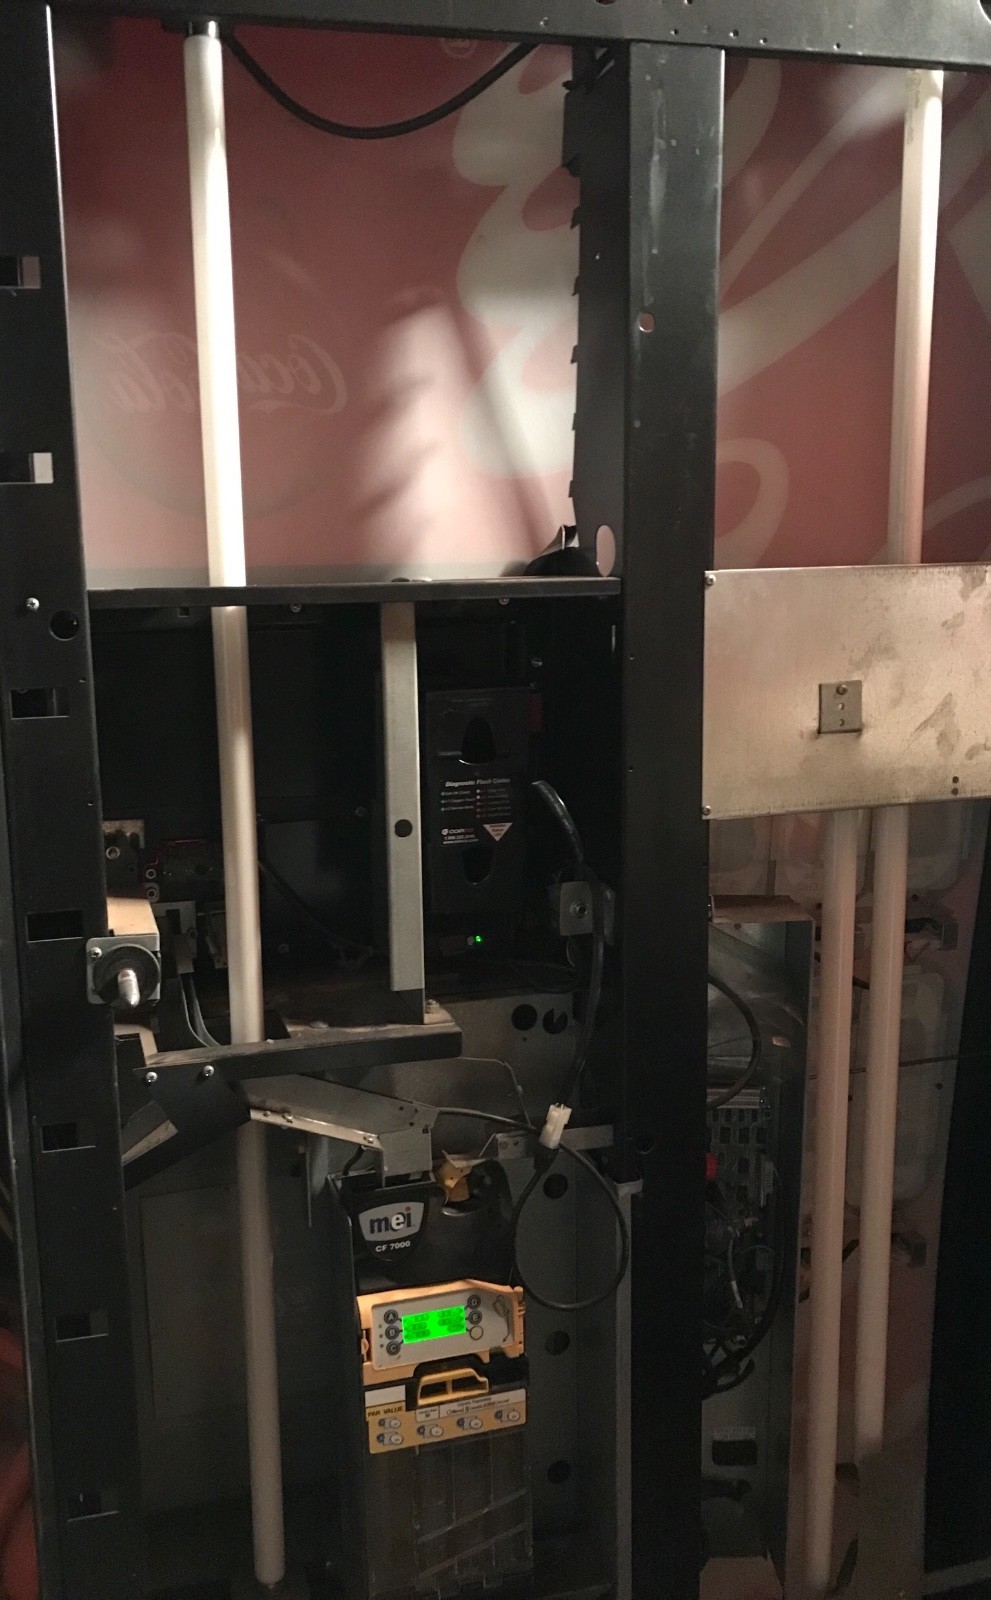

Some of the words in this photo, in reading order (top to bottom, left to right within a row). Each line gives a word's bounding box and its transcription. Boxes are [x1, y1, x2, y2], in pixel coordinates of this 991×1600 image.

[370, 1206, 412, 1234] mei
[375, 1245, 388, 1253] CF
[390, 1240, 411, 1250] 7000
[367, 1408, 381, 1417] PAR
[383, 1405, 403, 1415] VALUE
